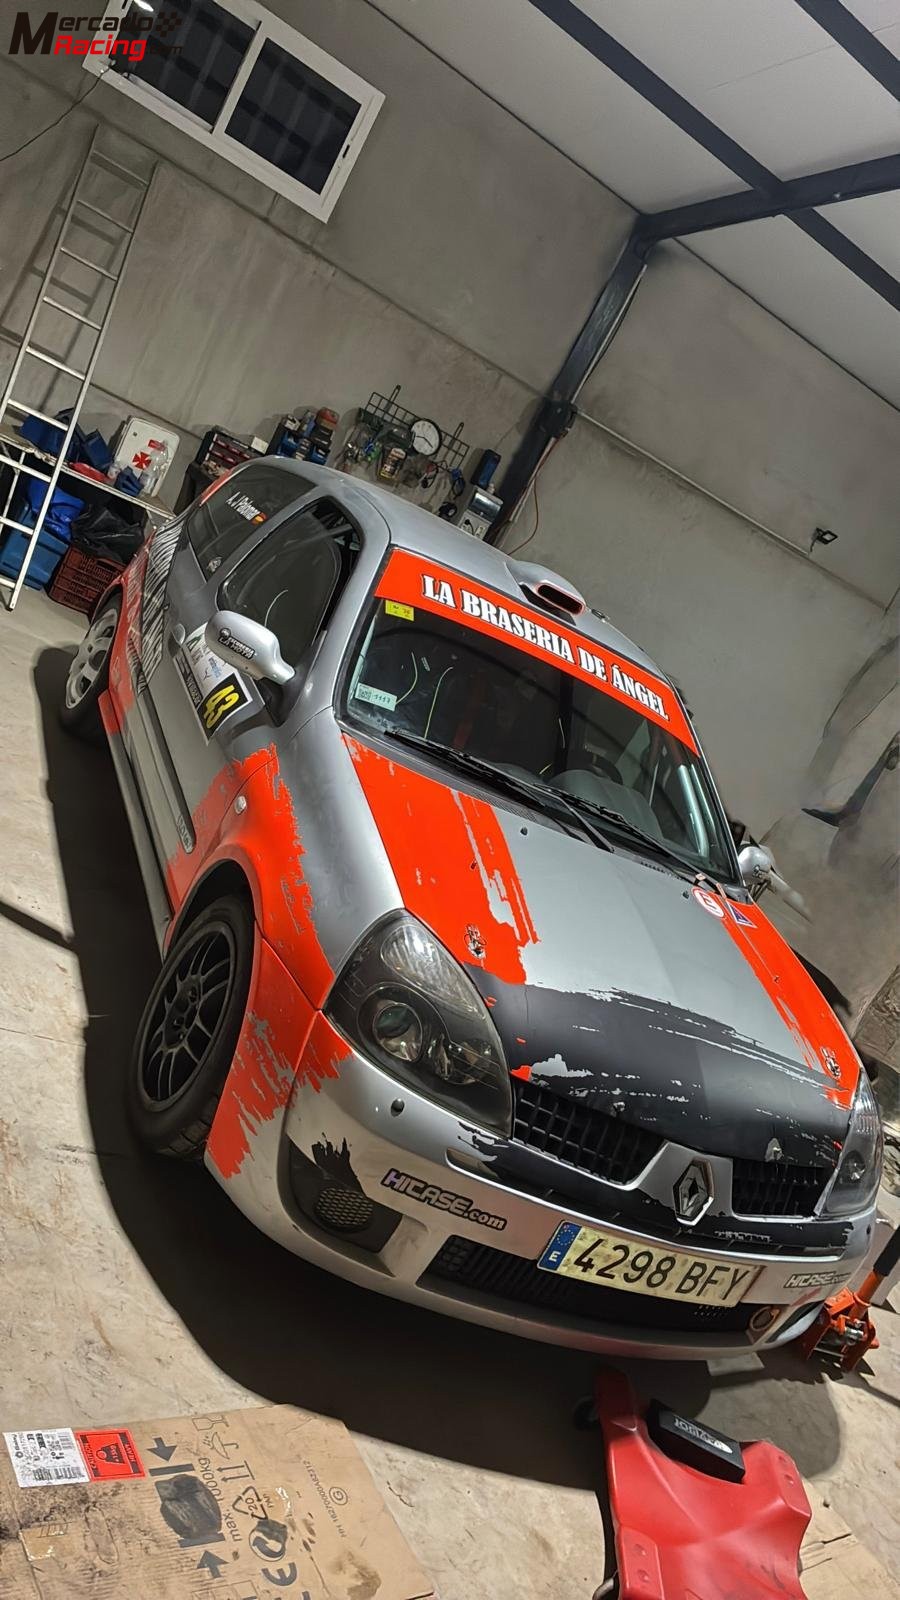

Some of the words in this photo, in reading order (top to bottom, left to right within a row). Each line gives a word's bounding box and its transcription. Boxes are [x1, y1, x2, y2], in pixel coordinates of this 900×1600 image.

[421, 574, 456, 608] LA
[460, 588, 576, 664] BRASERIA
[577, 646, 608, 682] DE
[611, 664, 670, 721] ÁNGEL
[203, 684, 240, 729] 43
[381, 1167, 507, 1231] HICASE.com
[549, 1251, 561, 1262] E
[573, 1238, 676, 1288] 4298
[675, 1261, 750, 1301] BFY
[245, 1497, 258, 1511] 20
